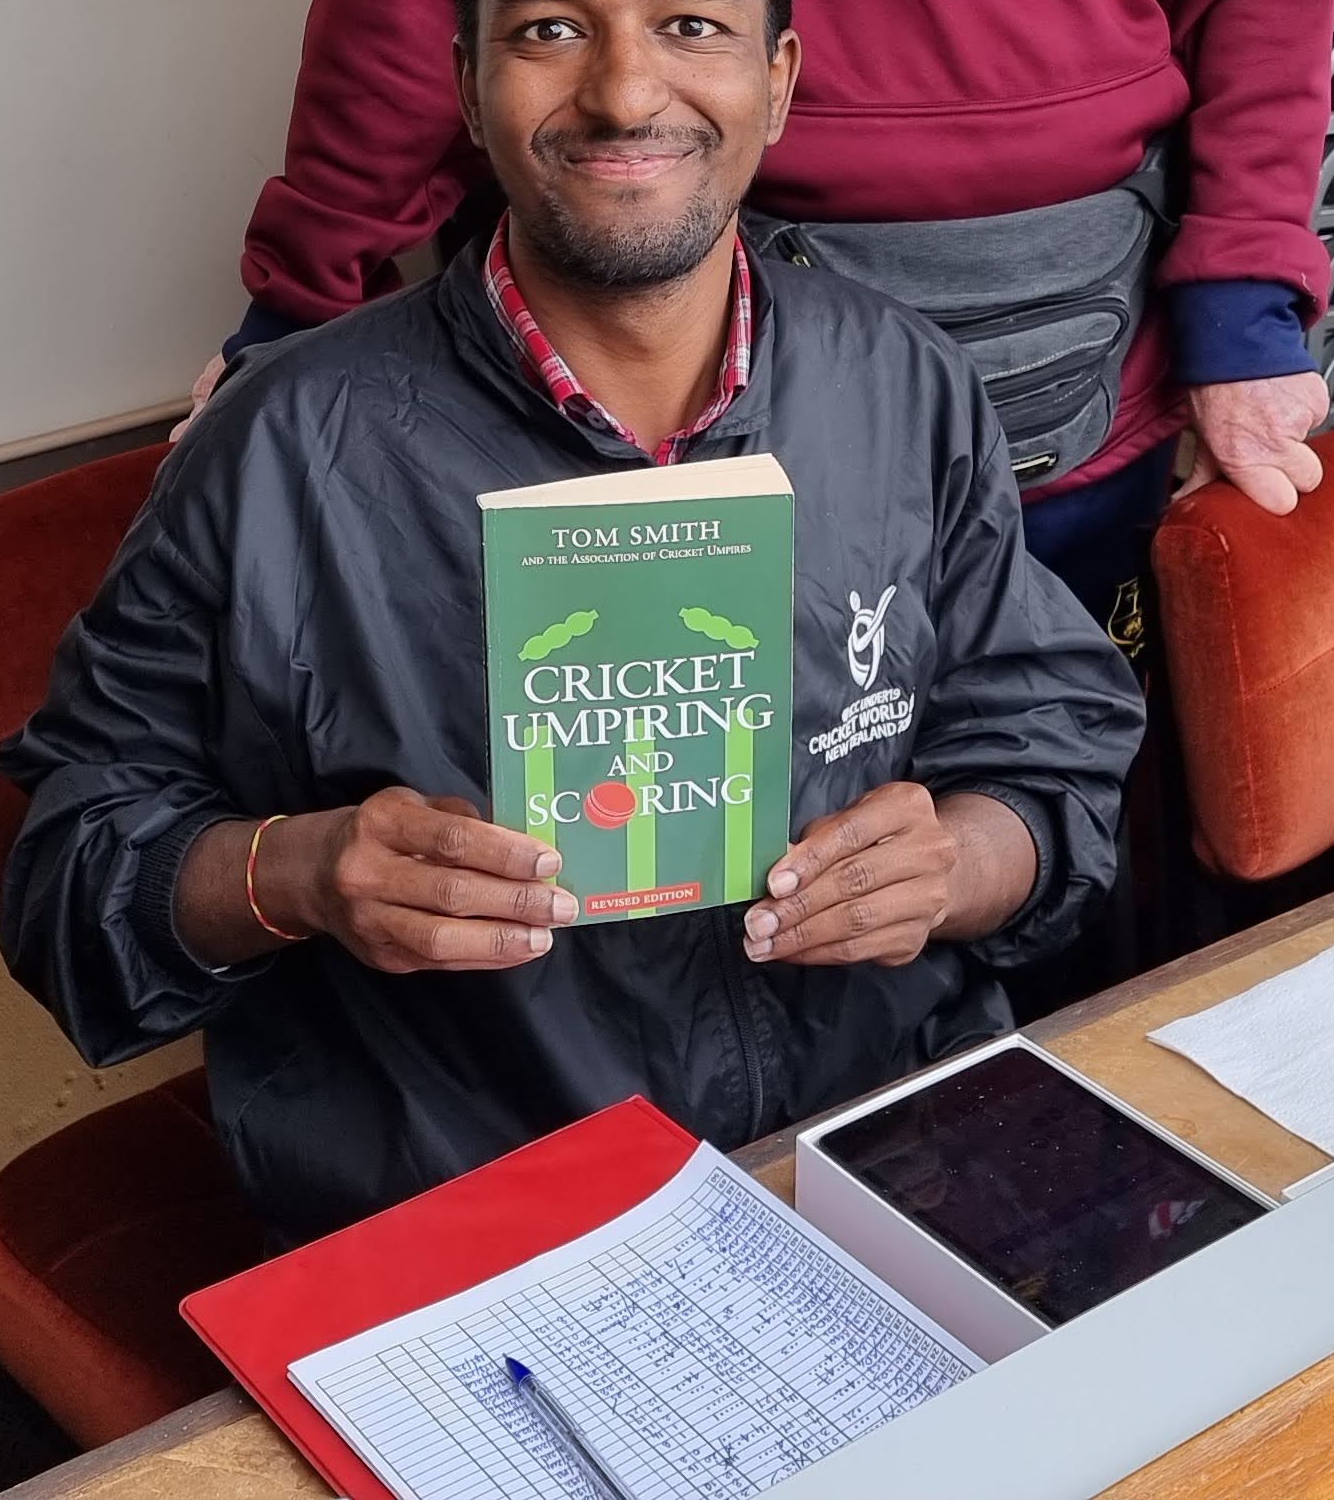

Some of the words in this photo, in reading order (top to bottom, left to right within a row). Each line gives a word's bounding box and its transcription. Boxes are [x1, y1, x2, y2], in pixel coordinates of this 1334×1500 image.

[552, 527, 619, 549] TOM
[630, 520, 721, 546] SMITH
[521, 556, 544, 566] AND
[547, 555, 568, 565] THE
[642, 551, 656, 562] OF
[524, 650, 755, 704] CRICKET
[503, 693, 774, 751] UMPIRING
[808, 714, 859, 755] CRICKET
[858, 700, 909, 729] WORLD
[607, 751, 674, 777] AND
[825, 740, 849, 765] NEW
[590, 895, 640, 910] REVISED
[643, 888, 694, 904] EDITION
